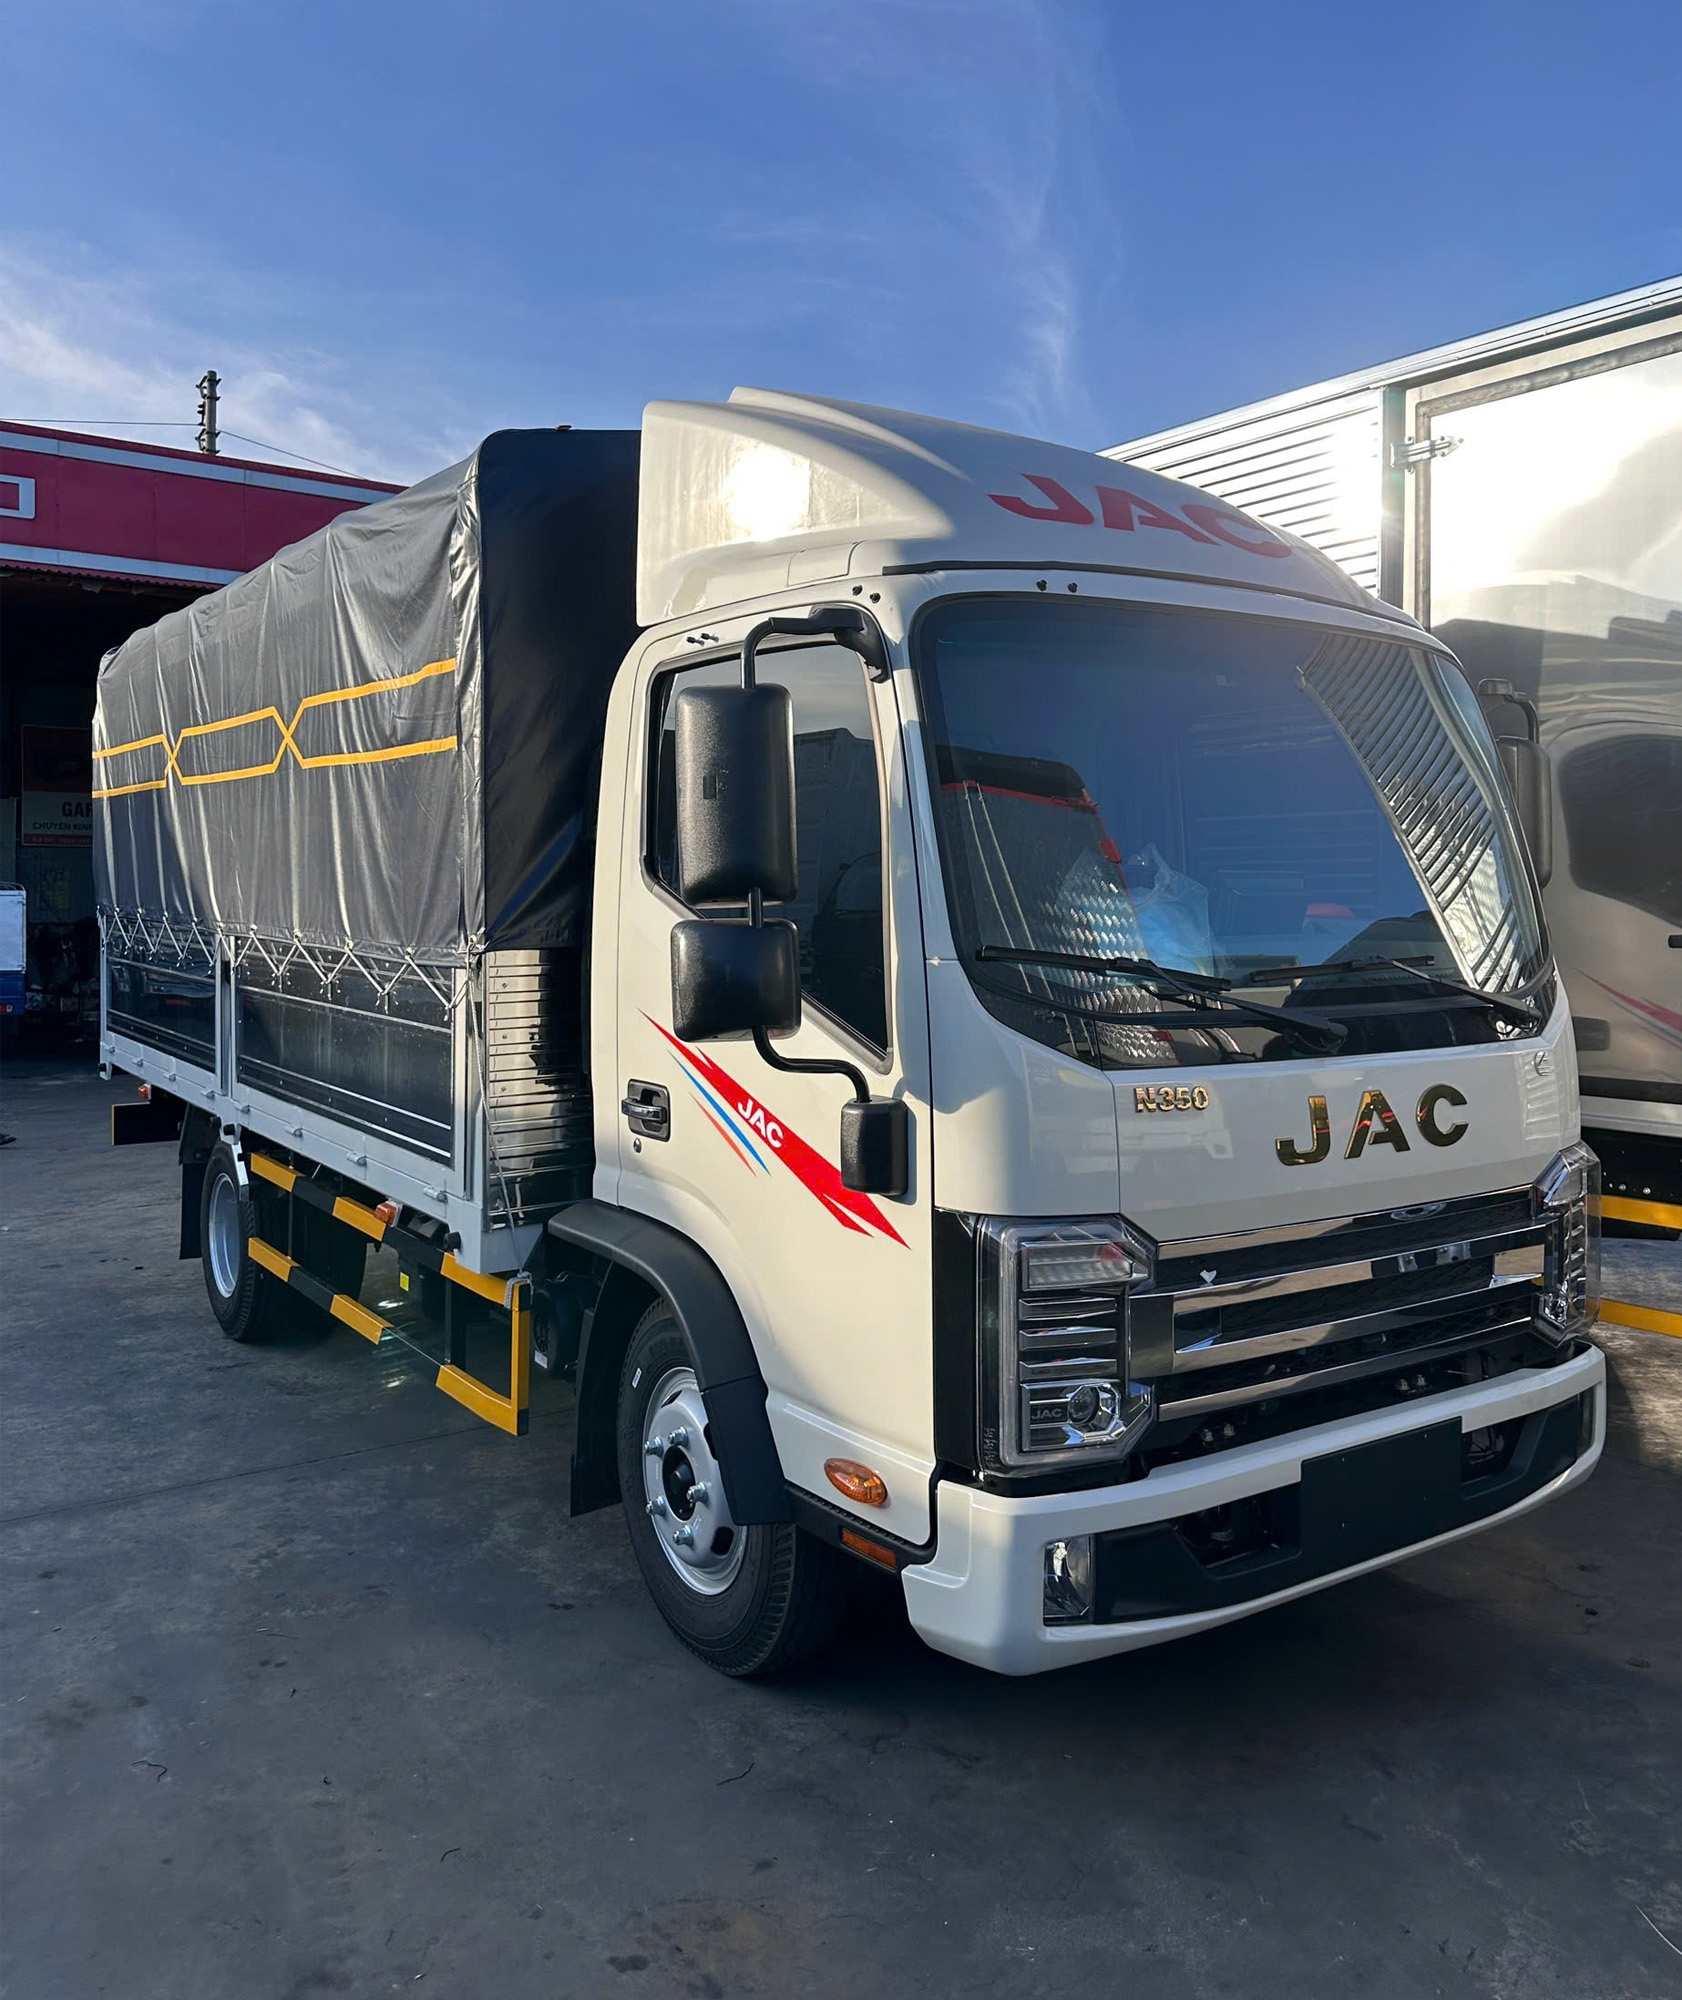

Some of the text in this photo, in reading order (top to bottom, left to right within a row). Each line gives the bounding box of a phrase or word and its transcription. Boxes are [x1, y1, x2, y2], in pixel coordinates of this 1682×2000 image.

[986, 472, 1291, 558] JAC
[737, 1098, 784, 1148] JAC
[1134, 1085, 1210, 1113] N350
[1275, 1083, 1469, 1166] JAC
[1030, 1407, 1063, 1420] JAC
